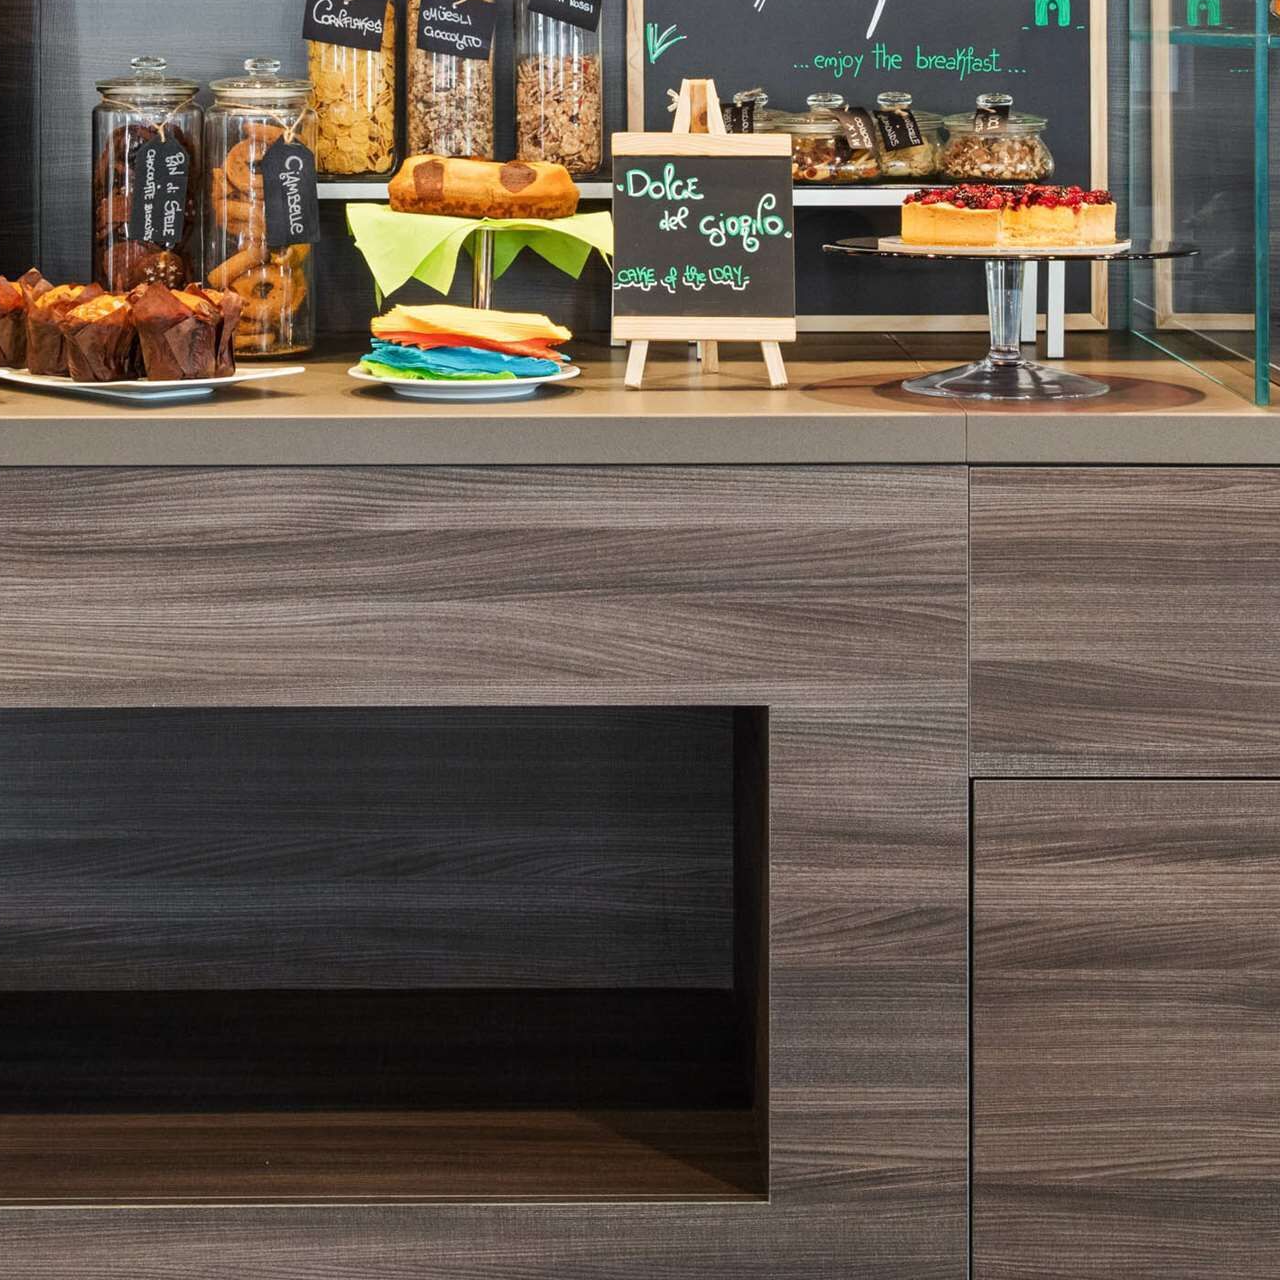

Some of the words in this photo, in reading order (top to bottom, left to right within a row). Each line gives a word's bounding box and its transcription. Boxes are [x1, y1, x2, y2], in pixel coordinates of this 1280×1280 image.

[871, 43, 902, 71] the
[166, 182, 180, 193] di
[659, 206, 689, 231] del
[617, 267, 655, 285] CAKE
[664, 267, 678, 288] of
[684, 265, 707, 285] the
[712, 265, 743, 286] DAY
